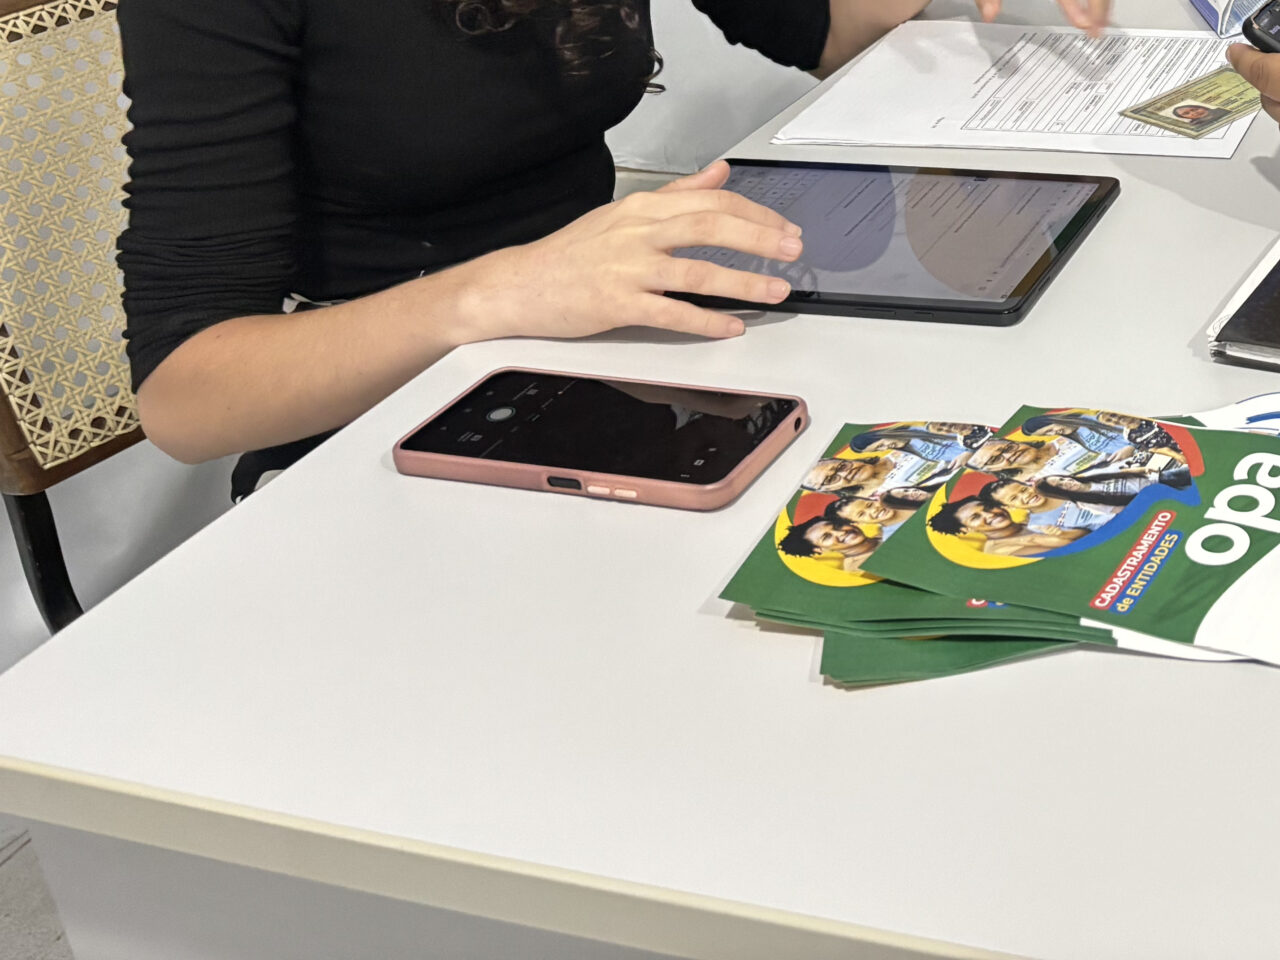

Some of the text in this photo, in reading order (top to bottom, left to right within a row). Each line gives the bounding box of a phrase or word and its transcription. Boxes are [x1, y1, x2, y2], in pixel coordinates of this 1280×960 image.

[1094, 512, 1172, 608] CADASTRAMENTO
[1116, 533, 1179, 613] de ENTIDADES
